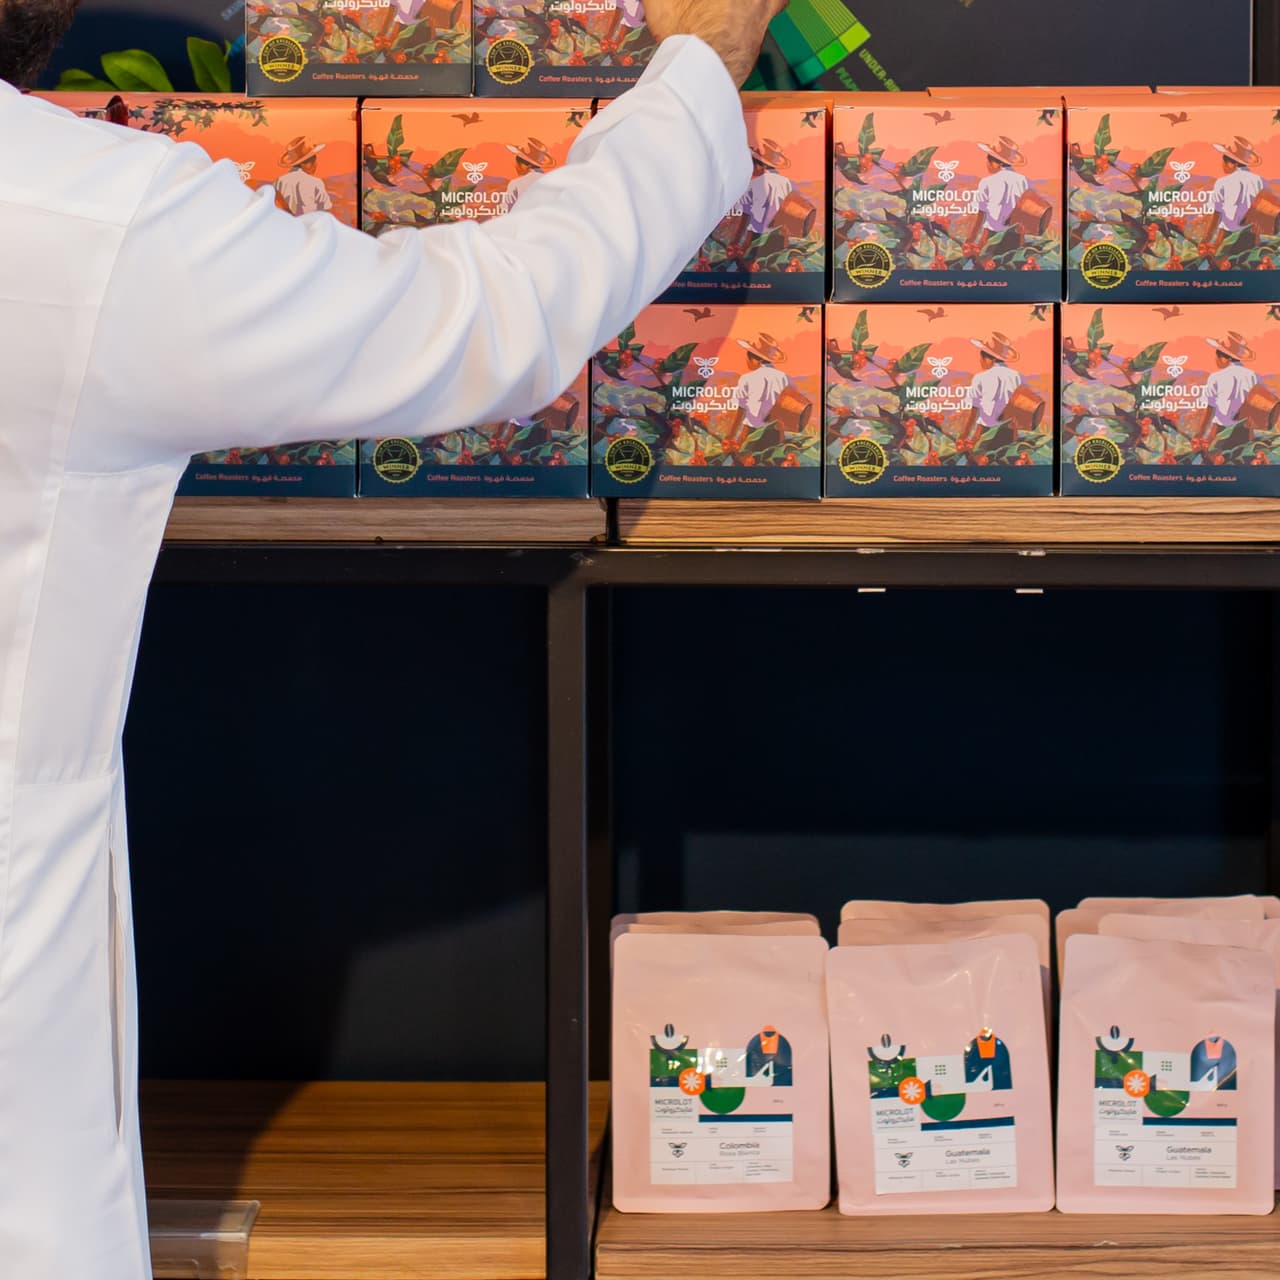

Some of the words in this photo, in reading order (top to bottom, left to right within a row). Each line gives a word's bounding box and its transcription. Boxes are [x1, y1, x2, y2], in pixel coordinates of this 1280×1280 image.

[550, 0, 617, 13] مايكرولوت
[312, 72, 334, 81] Coffee
[335, 72, 366, 81] Roasters
[538, 75, 560, 83] Coffee
[561, 75, 593, 83] Roasters
[441, 191, 507, 203] MICROLOT
[912, 190, 979, 202] MICROLOT
[1148, 191, 1215, 203] MICROLOT
[441, 204, 508, 218] مايكرولوت
[912, 203, 980, 217] مايكرولوت
[1148, 204, 1215, 217] مايكرولوت
[899, 279, 922, 287] Coffee
[923, 279, 954, 287] Roasters
[1135, 279, 1157, 287] Coffee
[1159, 279, 1189, 287] Roasters
[672, 386, 738, 398] MICROLOT
[906, 386, 973, 398] MICROLOT
[1141, 385, 1208, 397] MICROLOT
[672, 399, 739, 413] مايكرولوت
[906, 399, 973, 413] مايكرولوت
[1141, 398, 1209, 412] مايكرولوت
[658, 474, 681, 483] Coffee
[682, 474, 713, 483] Roasters
[893, 474, 915, 482] Coffee
[916, 474, 948, 482] Roasters
[1128, 473, 1151, 481] Coffee
[1152, 473, 1183, 481] Roasters
[719, 1142, 760, 1150] Colombia
[1166, 1145, 1212, 1154] Guatemala
[945, 1148, 991, 1157] Guatemala
